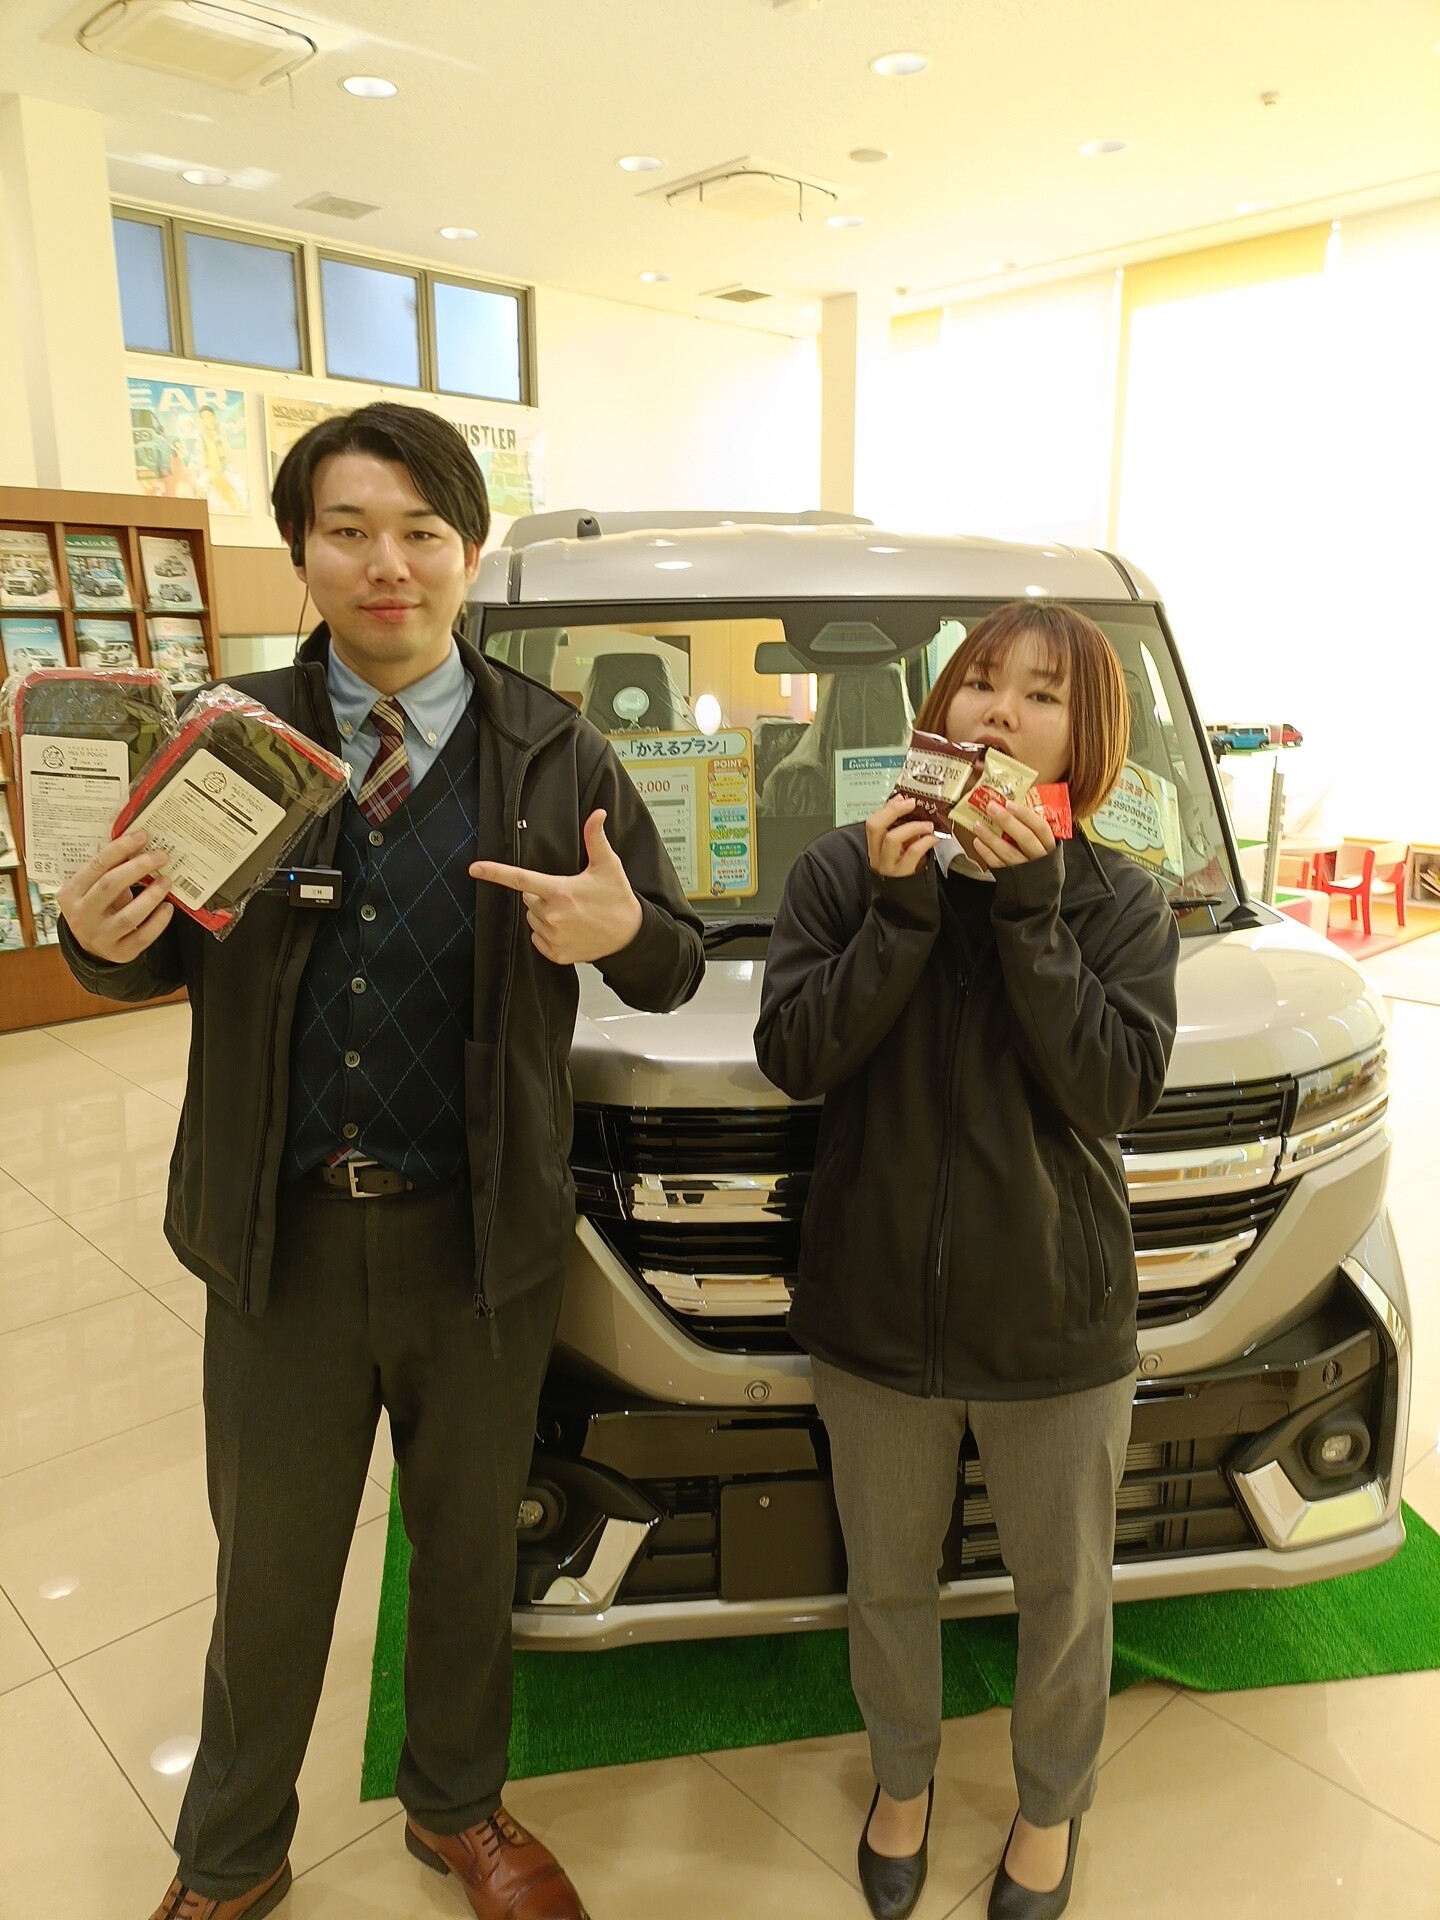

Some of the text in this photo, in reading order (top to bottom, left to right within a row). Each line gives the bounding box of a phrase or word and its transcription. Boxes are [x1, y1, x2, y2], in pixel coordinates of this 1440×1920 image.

[452, 423, 517, 450] USTLER
[713, 758, 743, 768] POINT
[905, 759, 943, 778] CHOCO
[943, 767, 962, 780] PIE
